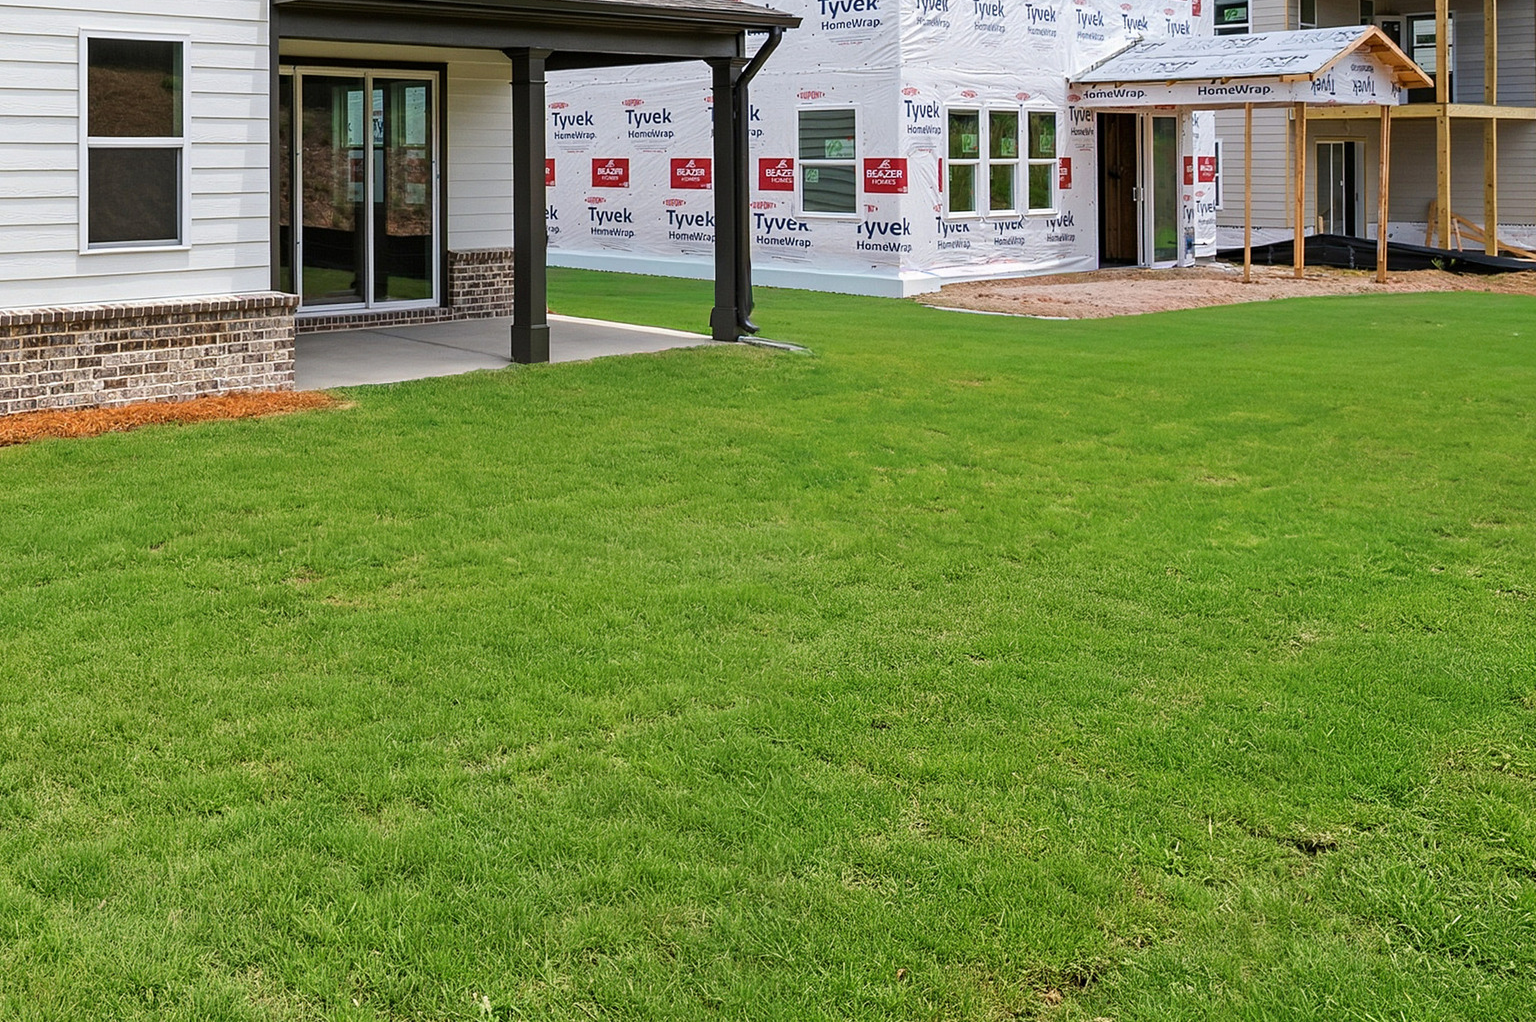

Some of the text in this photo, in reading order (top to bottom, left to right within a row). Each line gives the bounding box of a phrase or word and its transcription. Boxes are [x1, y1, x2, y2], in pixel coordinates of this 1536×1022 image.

[1025, 4, 1056, 25] Tyvek
[1076, 9, 1104, 29] Tyvek
[821, 18, 880, 30] HomeWrap
[1197, 85, 1271, 96] HomeWrap
[625, 108, 672, 128] Tyvek
[904, 100, 940, 122] Tyvek
[552, 111, 594, 130] Tyvek
[628, 130, 674, 139] HomeWrap
[765, 168, 794, 177] BEAZE
[866, 168, 903, 179] BEAZER
[588, 206, 632, 226] Tyvek
[666, 209, 715, 229] Tyvek
[590, 227, 635, 239] HomeWrap
[756, 235, 812, 249] HomeWrap
[857, 240, 912, 253] HomeWrap
